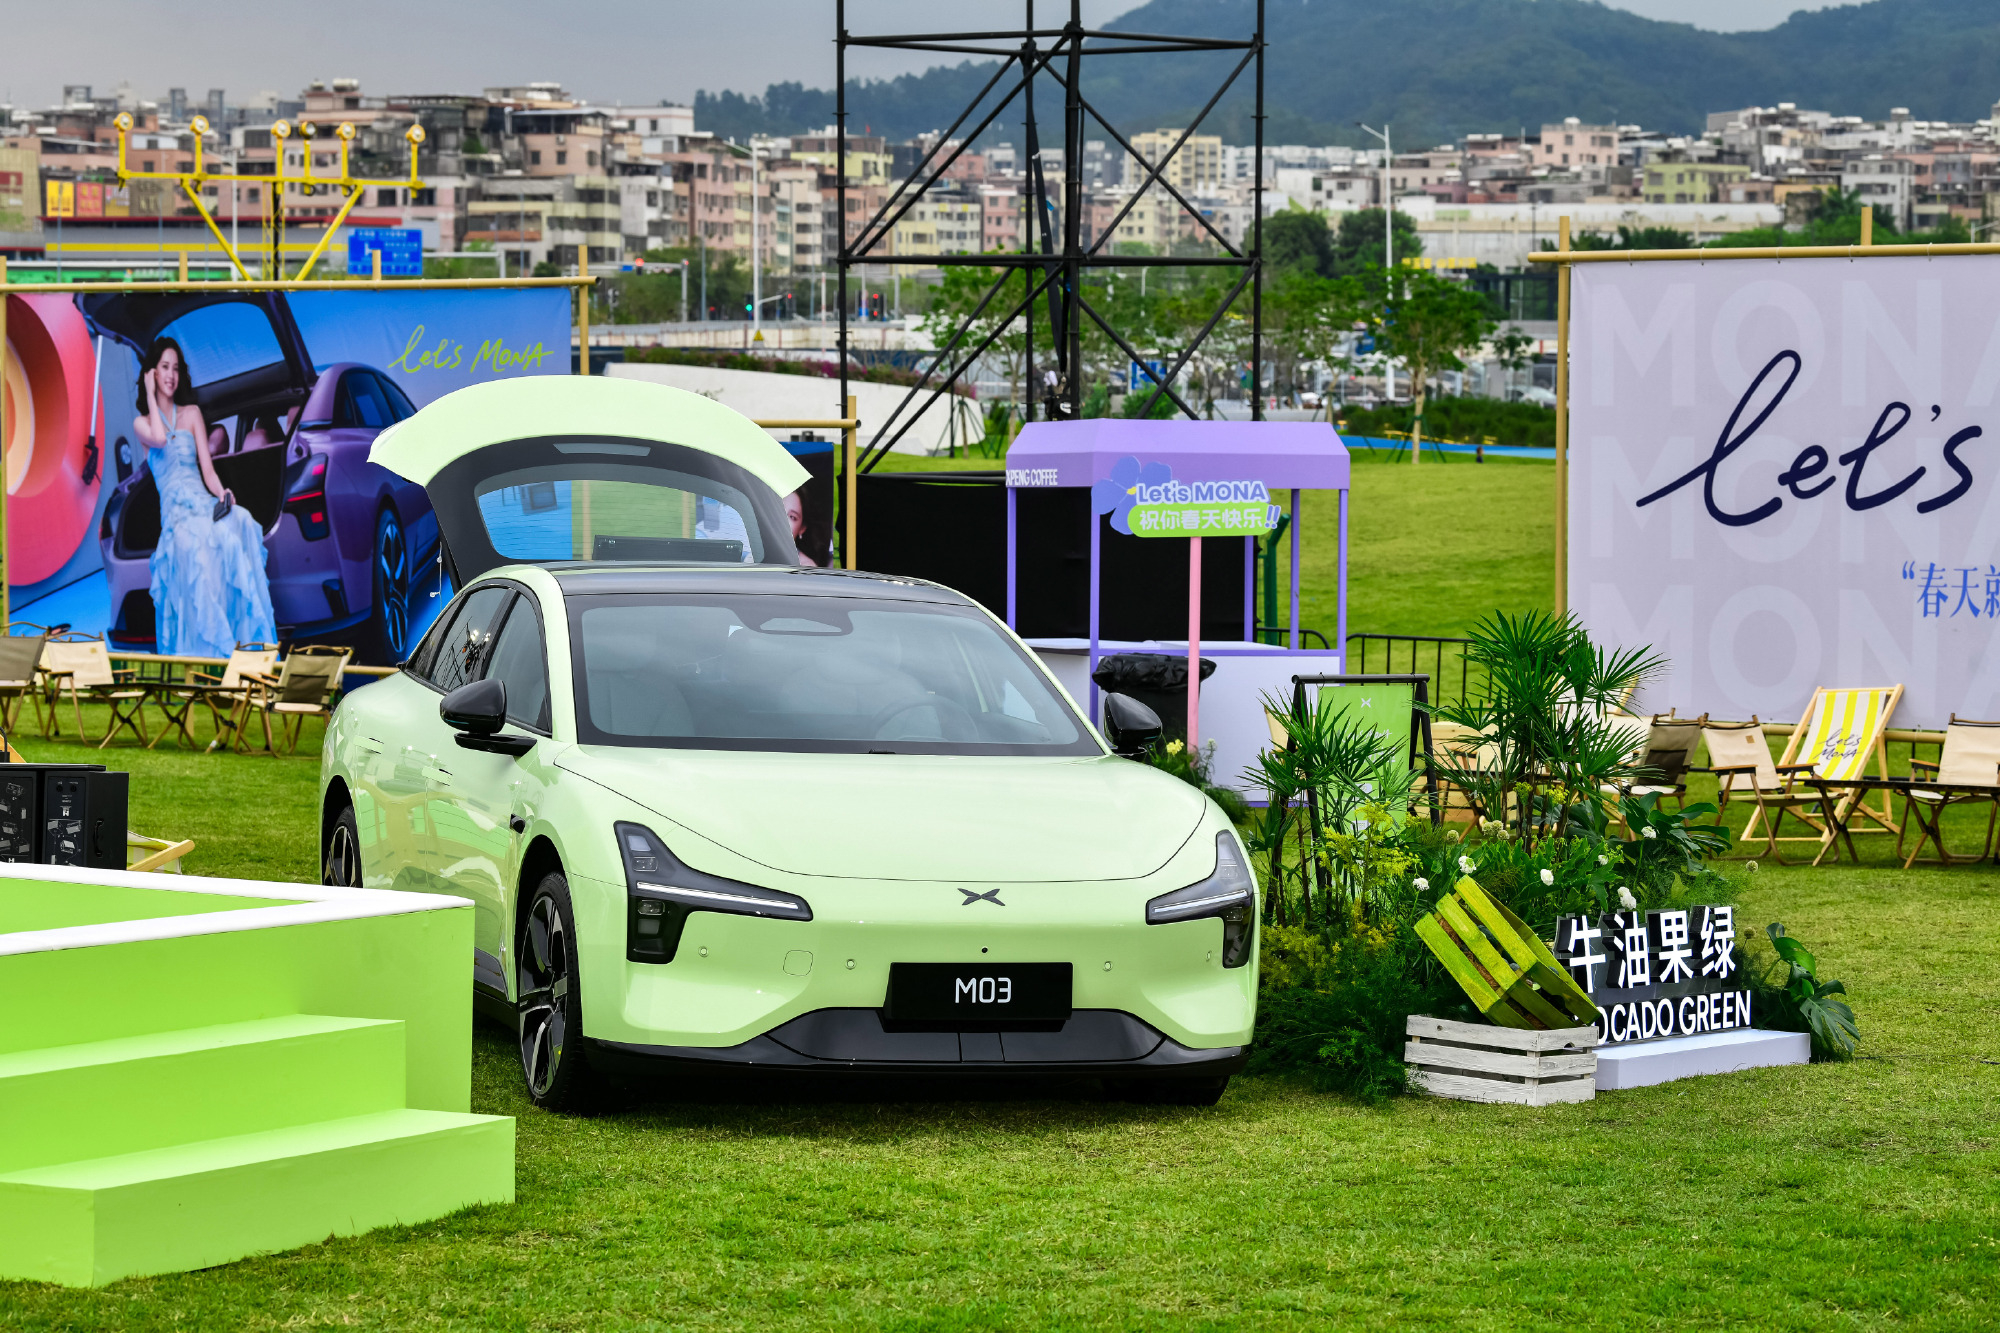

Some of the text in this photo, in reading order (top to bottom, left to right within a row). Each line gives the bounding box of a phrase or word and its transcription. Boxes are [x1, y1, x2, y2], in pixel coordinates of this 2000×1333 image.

[1591, 279, 2000, 409] MON
[1005, 468, 1058, 487] XPENG COFFEE
[1137, 481, 1268, 503] Let's MONA
[1567, 905, 1736, 994] 牛油果绿
[954, 977, 1012, 1004] M03
[1590, 989, 1752, 1046] OCADO GREEN
